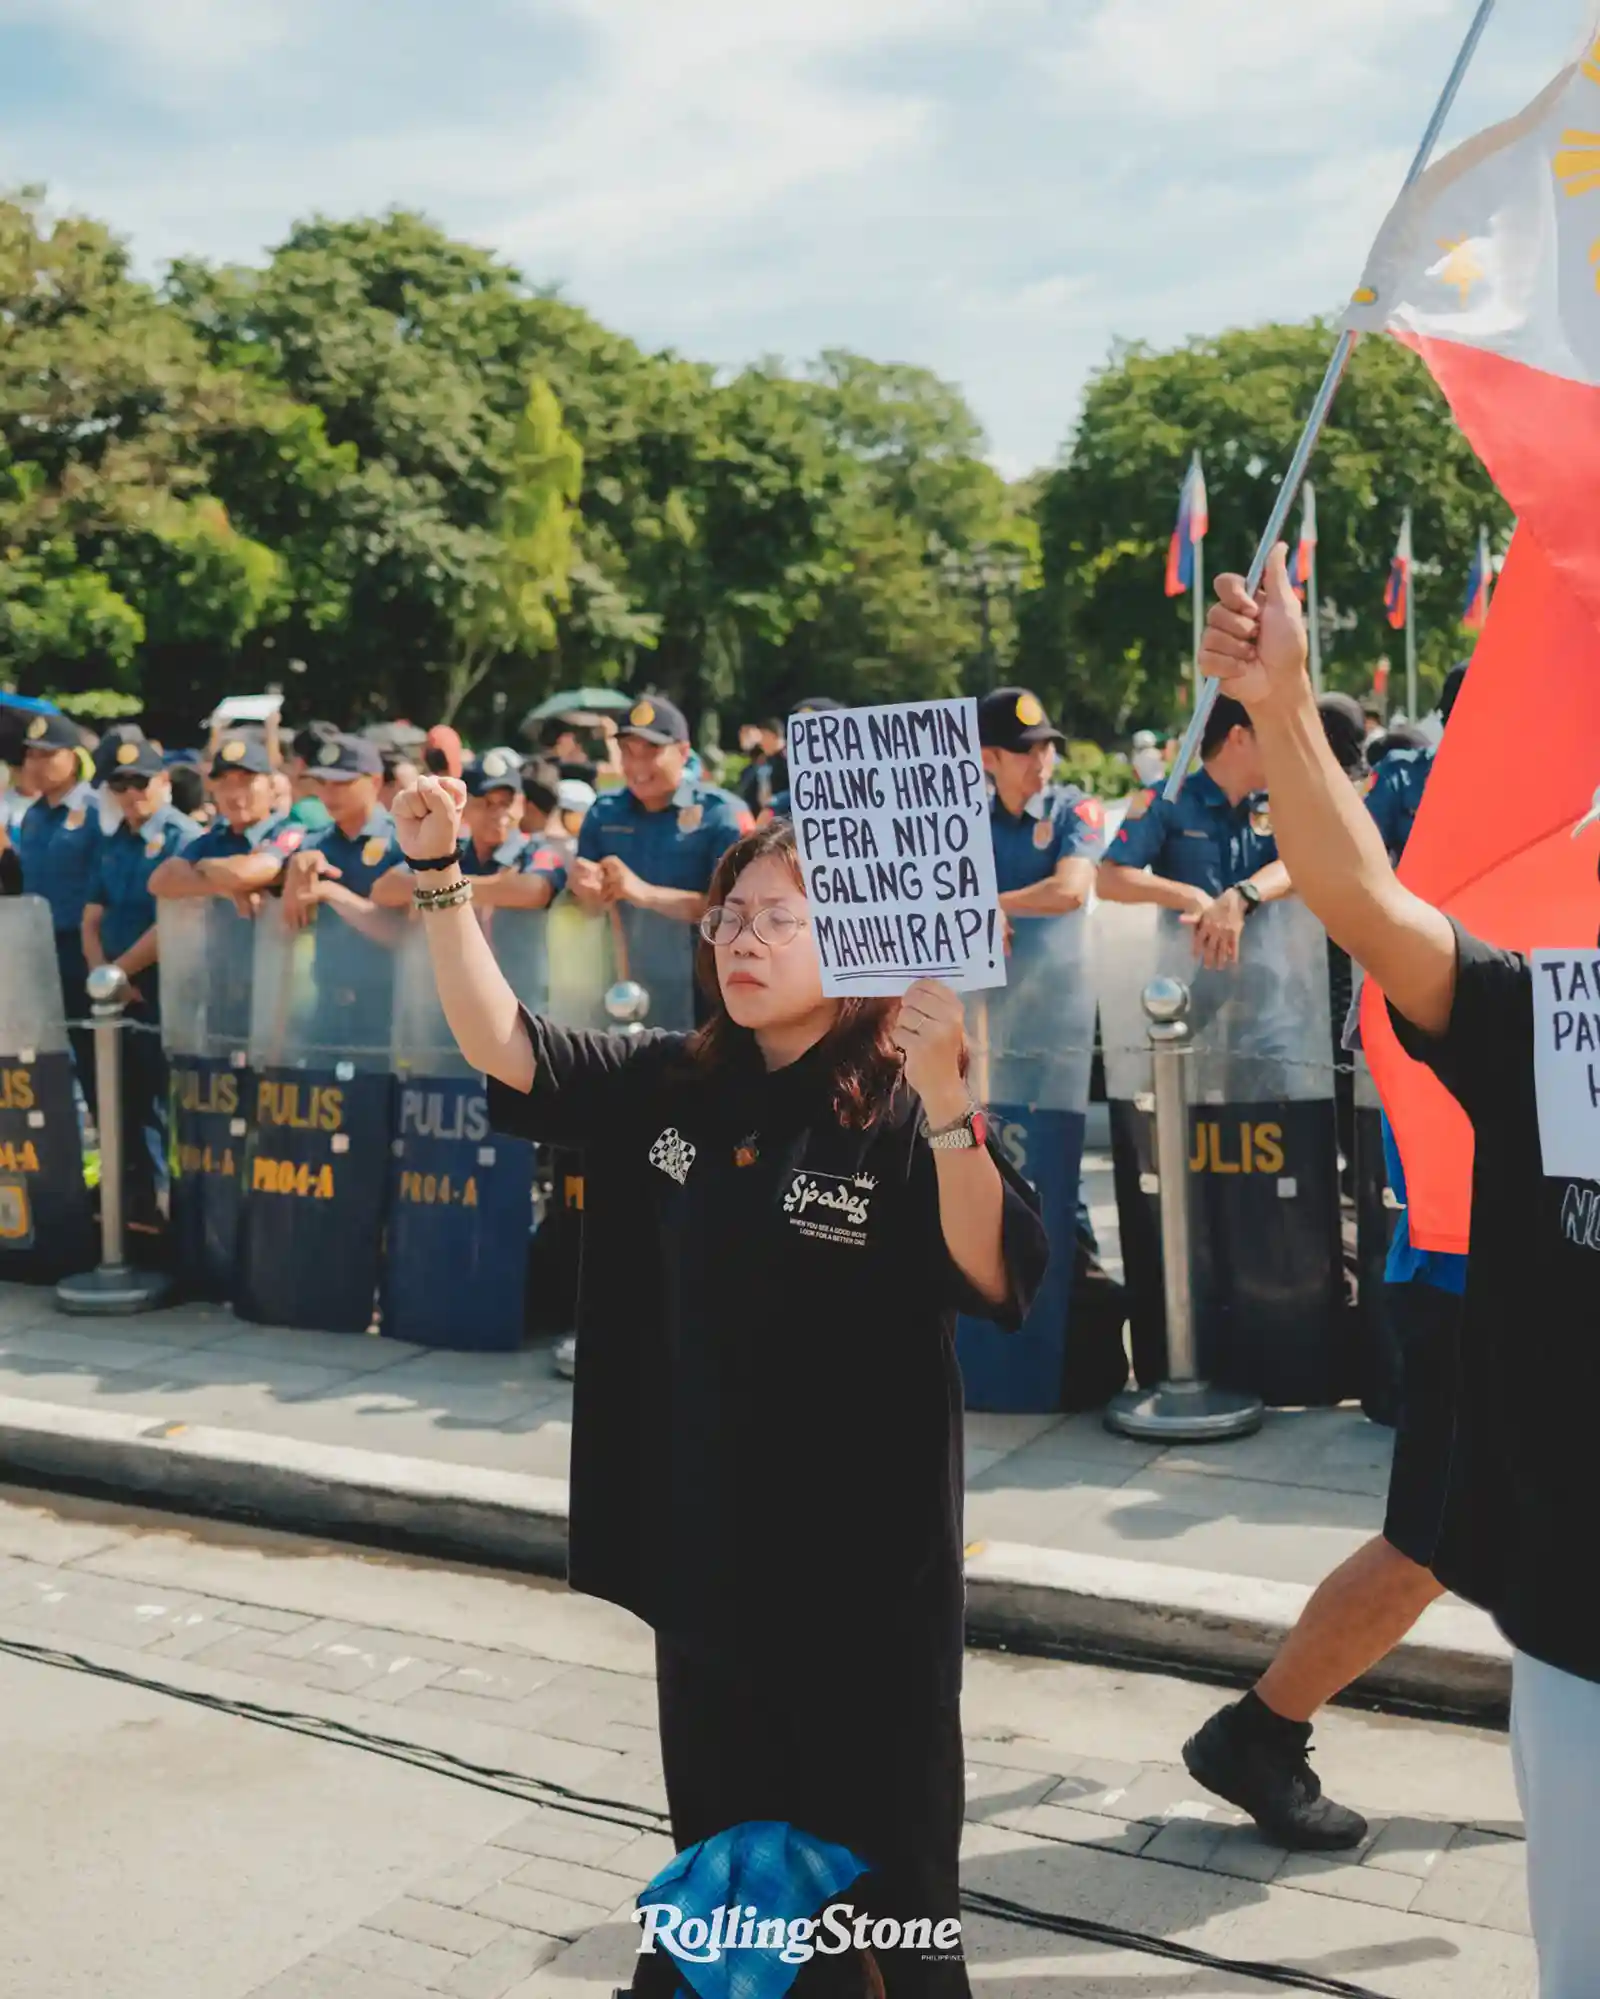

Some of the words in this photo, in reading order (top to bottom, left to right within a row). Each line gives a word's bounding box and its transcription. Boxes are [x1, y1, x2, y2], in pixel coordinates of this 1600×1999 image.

[791, 715, 864, 765] PERA
[868, 705, 971, 760] NAMIN
[794, 767, 885, 811] GALING
[892, 759, 982, 816] HIRAP,
[802, 817, 878, 860] PERA
[893, 812, 968, 857] NIYO
[811, 862, 923, 903] GALING
[933, 856, 980, 901] SA
[814, 908, 996, 969] MAHIHIRAP!
[258, 1081, 343, 1130] PULIS
[401, 1090, 489, 1141] PULIS
[783, 1174, 870, 1224] Spades
